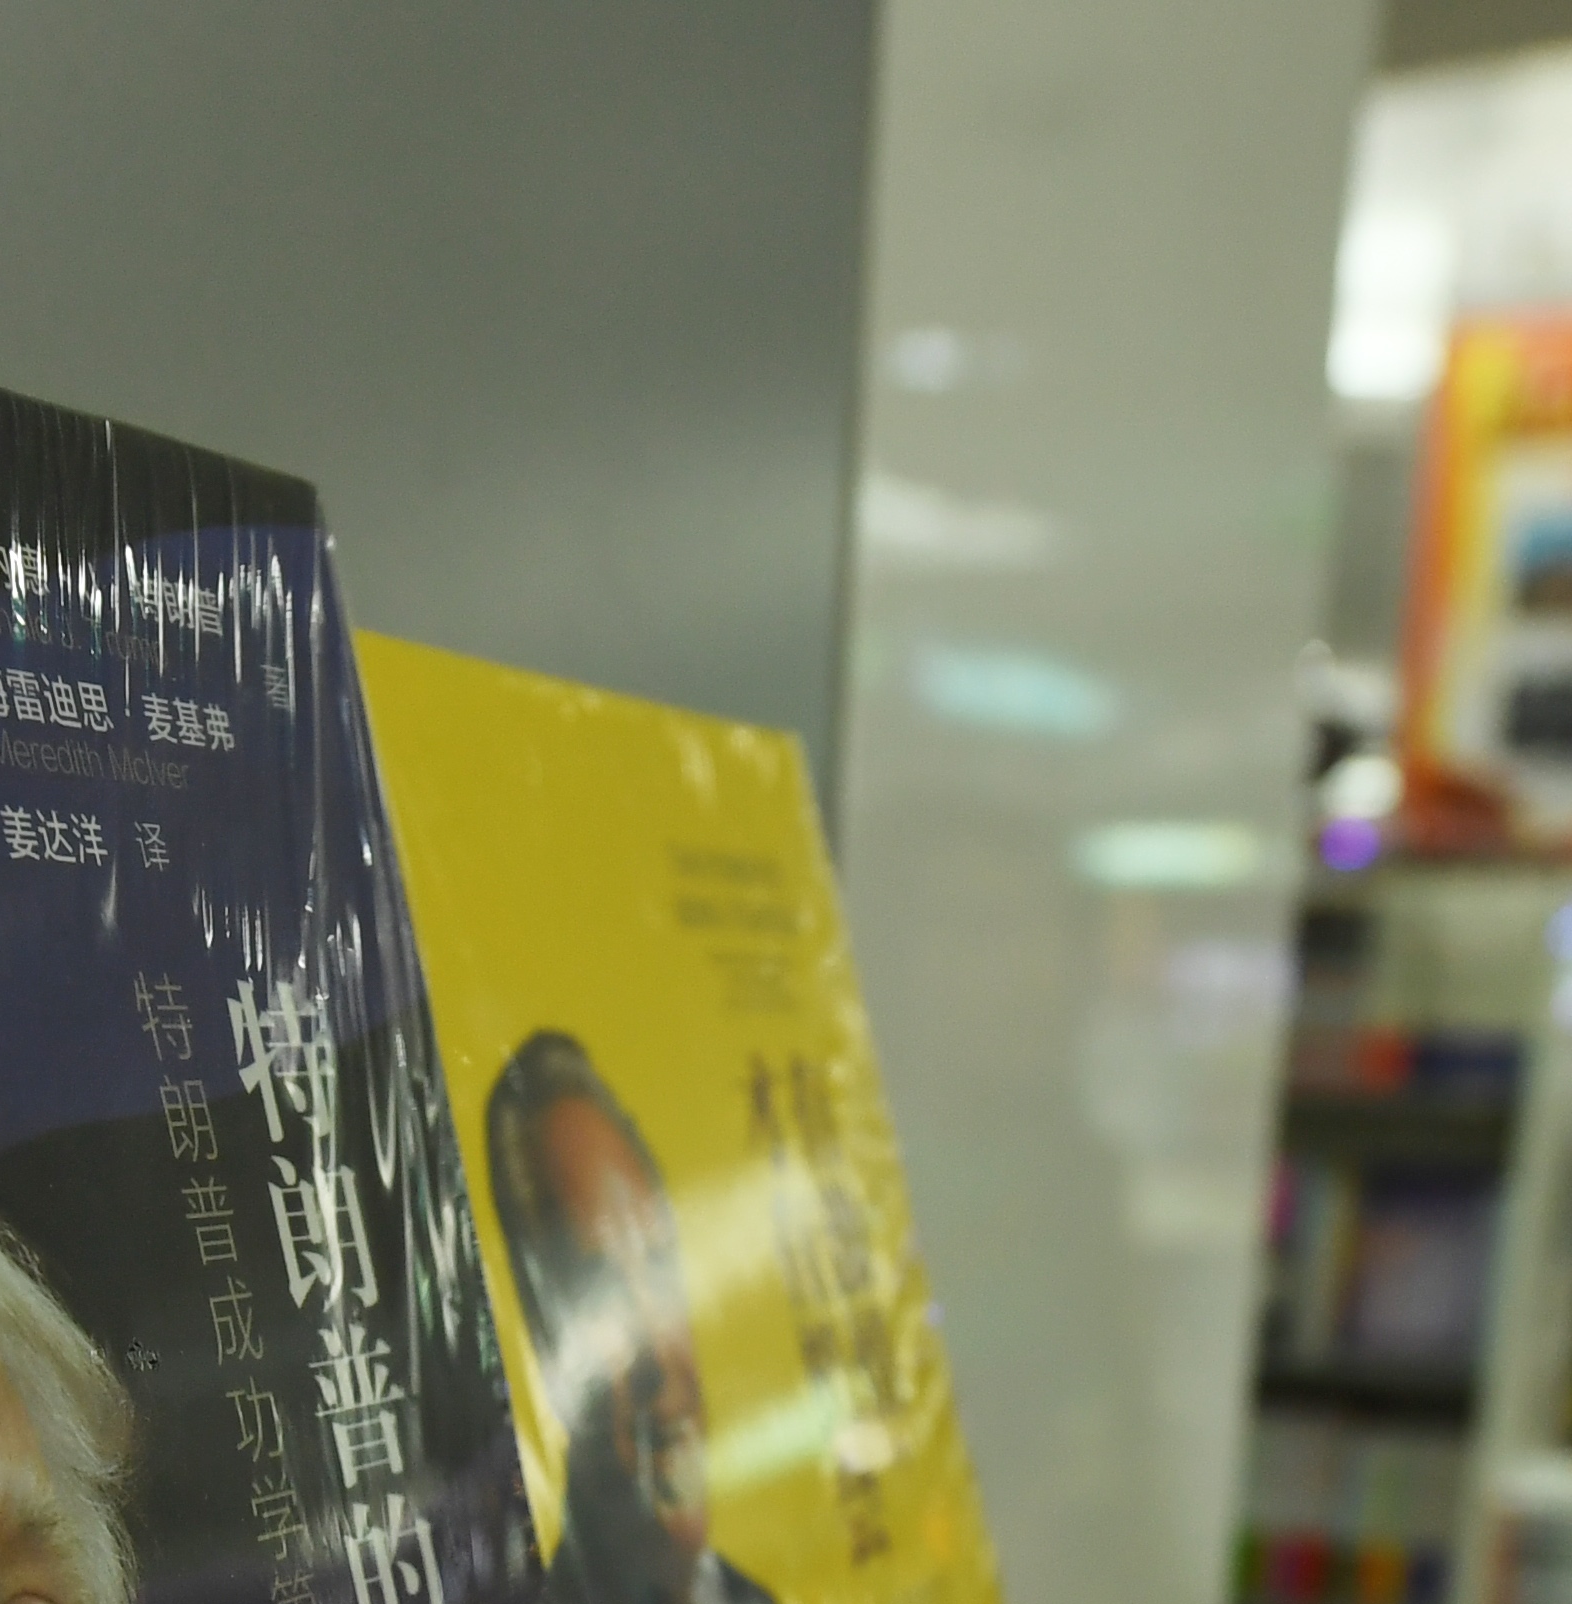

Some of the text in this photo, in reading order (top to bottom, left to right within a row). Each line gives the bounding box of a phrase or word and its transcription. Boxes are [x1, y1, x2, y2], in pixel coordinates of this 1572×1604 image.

[108, 743, 191, 790] McIver
[0, 804, 171, 873] 姜达洋 译
